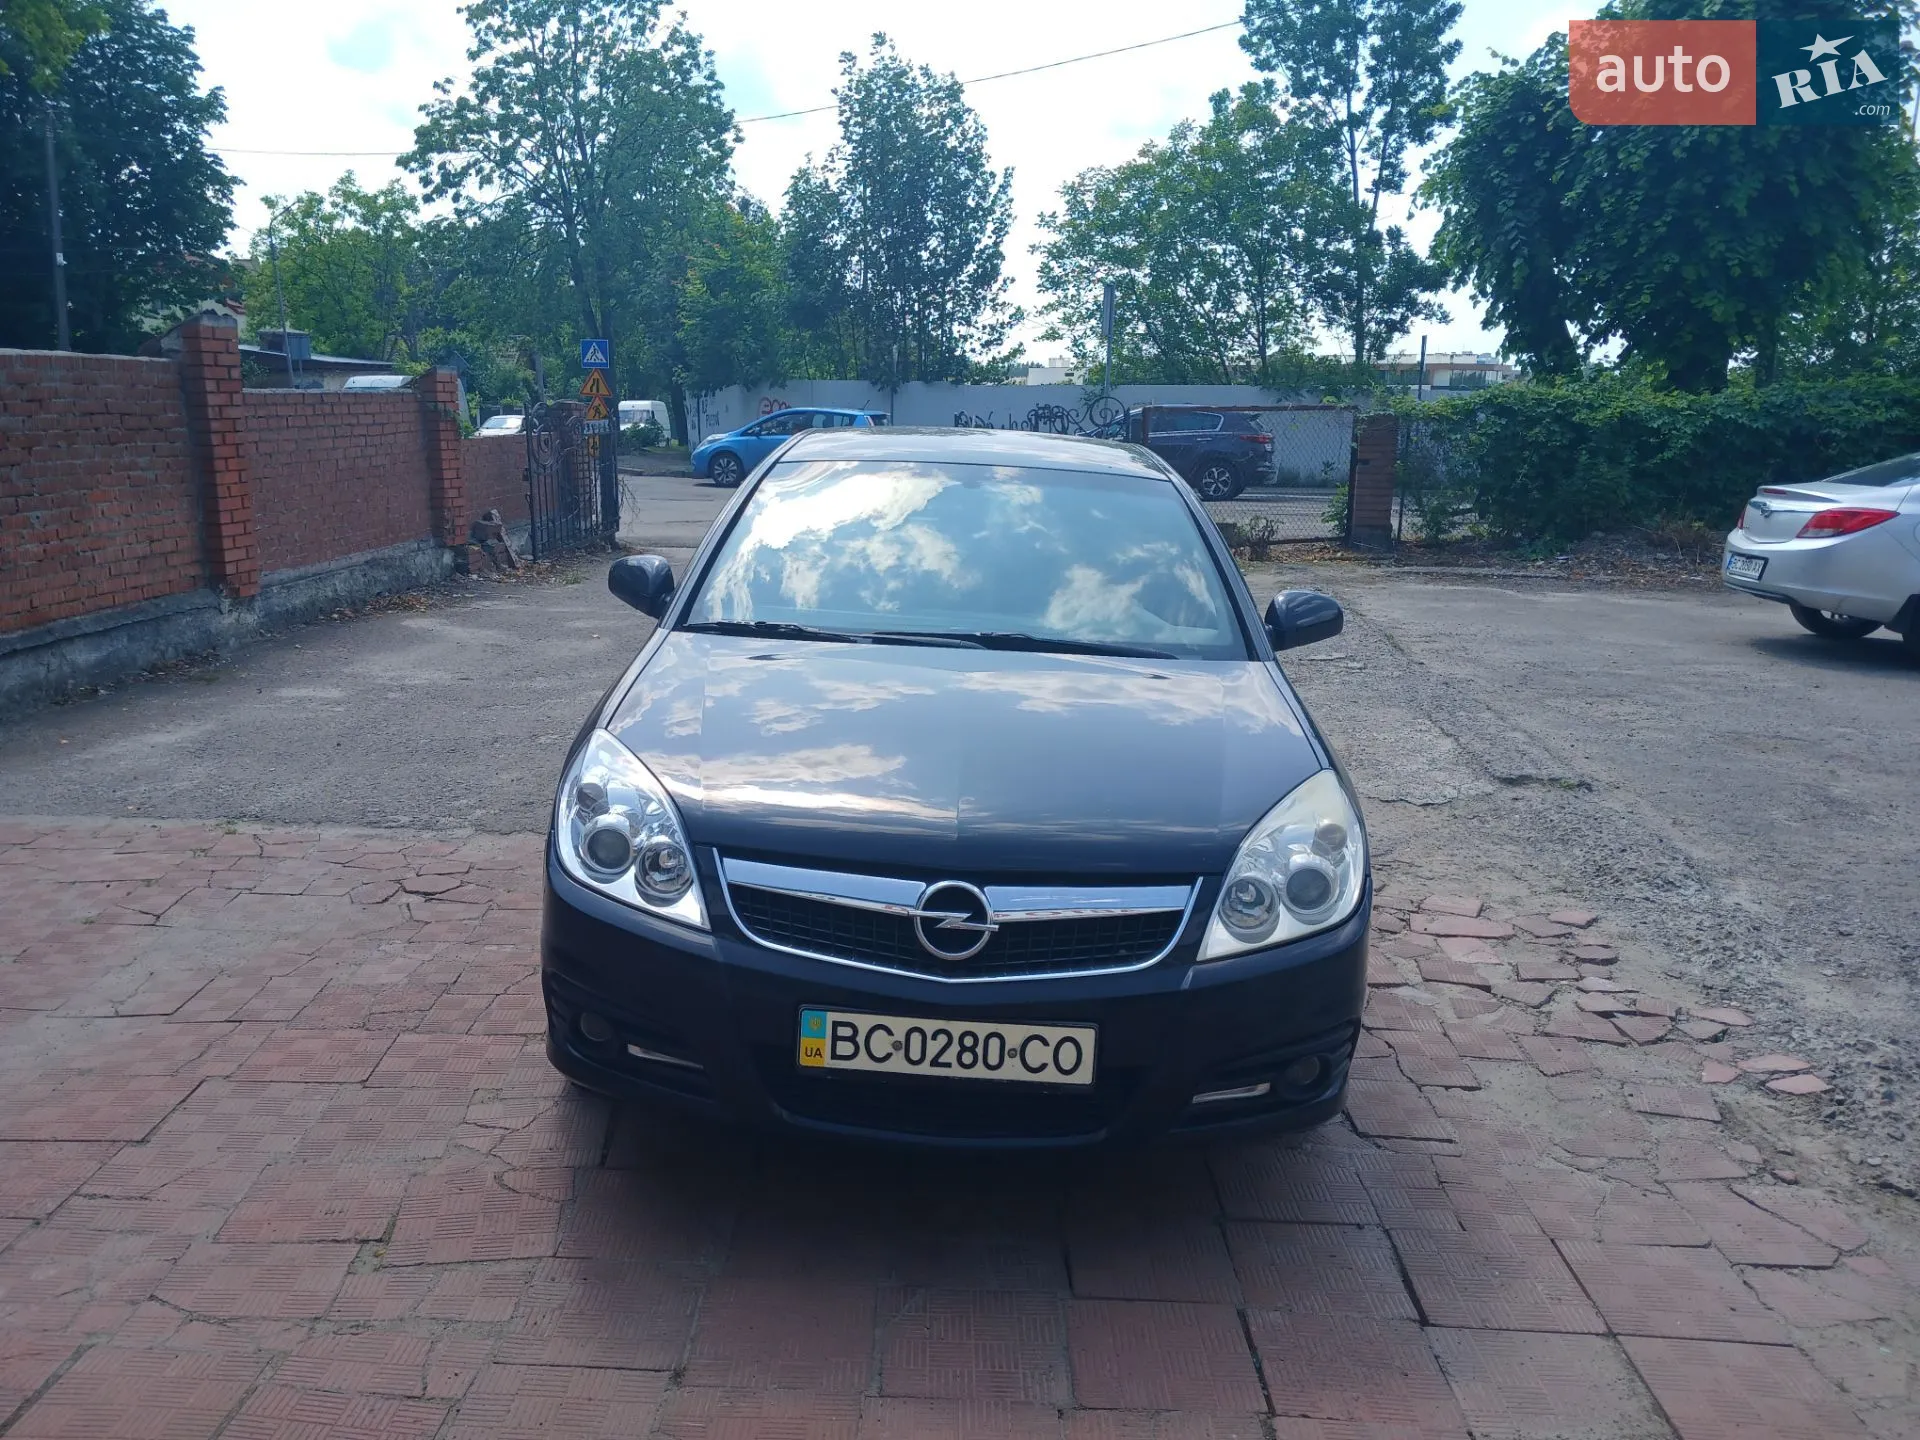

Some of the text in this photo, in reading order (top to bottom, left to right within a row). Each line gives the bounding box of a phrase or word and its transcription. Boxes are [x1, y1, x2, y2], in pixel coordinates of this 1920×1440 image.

[804, 1046, 823, 1059] UA
[830, 1020, 1083, 1076] BC 0280 CO
